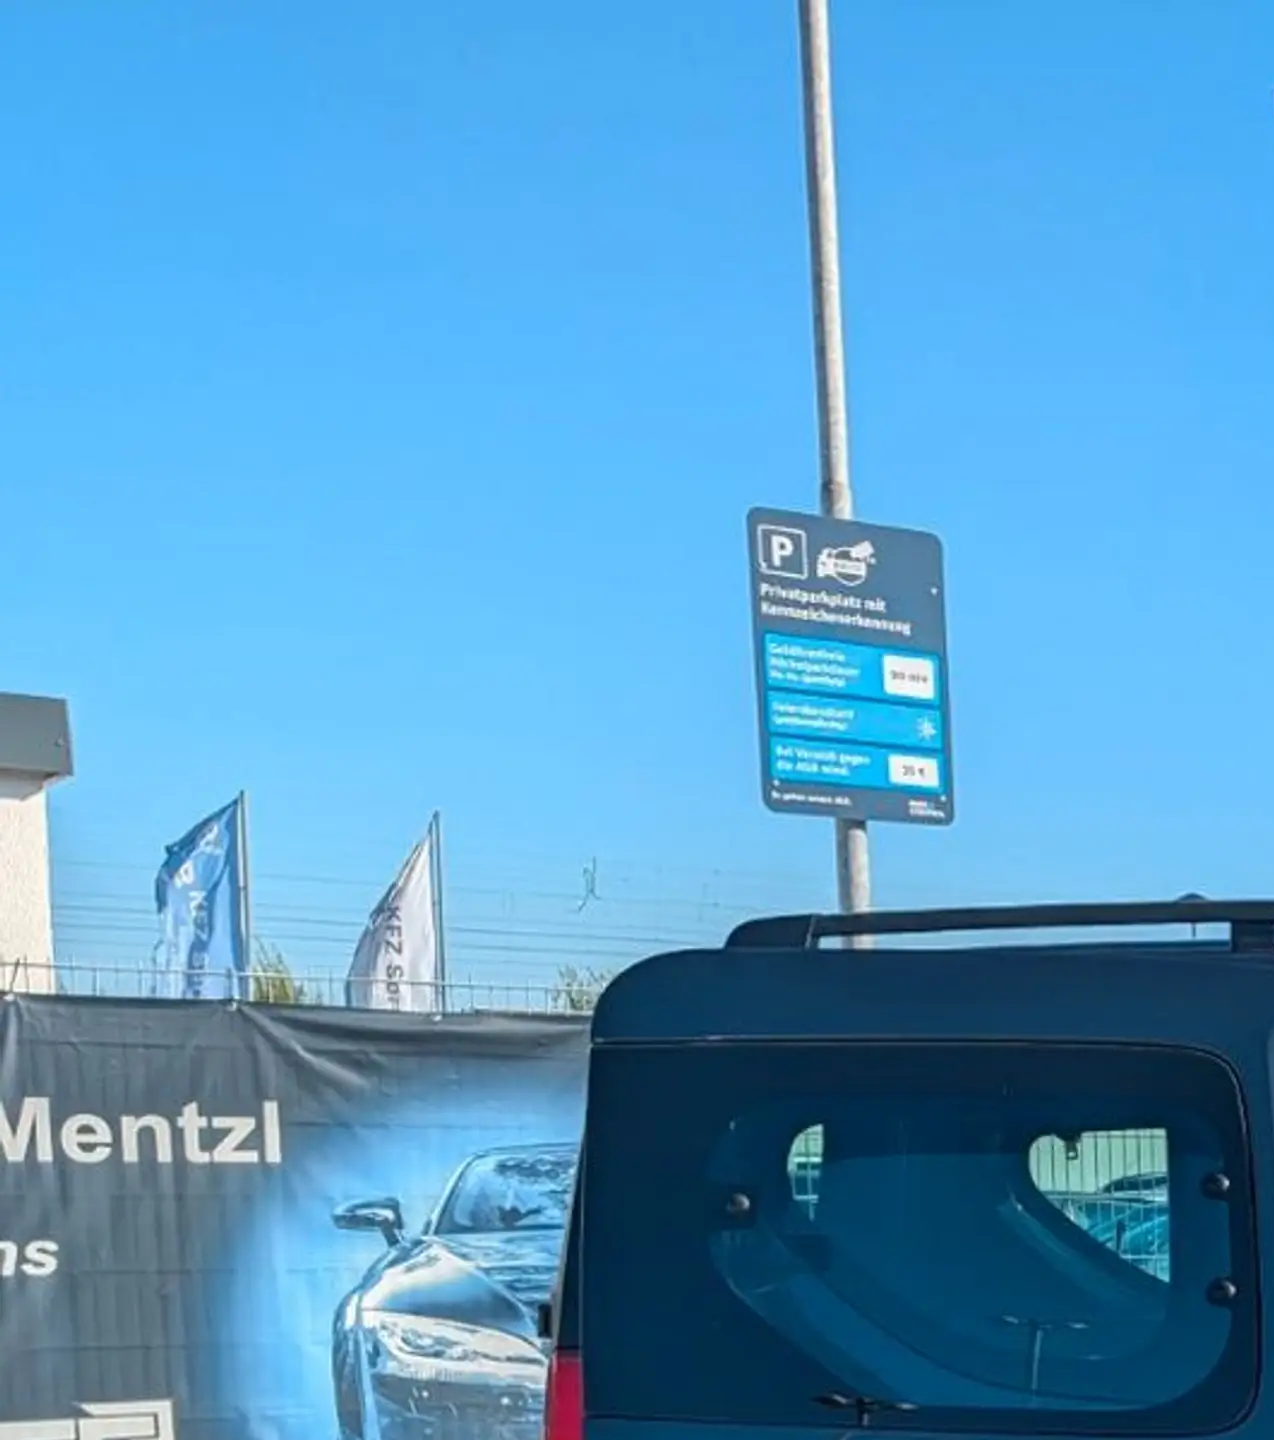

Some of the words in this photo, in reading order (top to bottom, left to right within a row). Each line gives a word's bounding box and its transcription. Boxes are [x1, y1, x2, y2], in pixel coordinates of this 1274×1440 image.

[770, 535, 794, 567] P
[760, 583, 862, 608] Privatparkplatz
[864, 597, 887, 613] mit
[384, 905, 402, 956] KFZ
[0, 1096, 282, 1164] Mentzl
